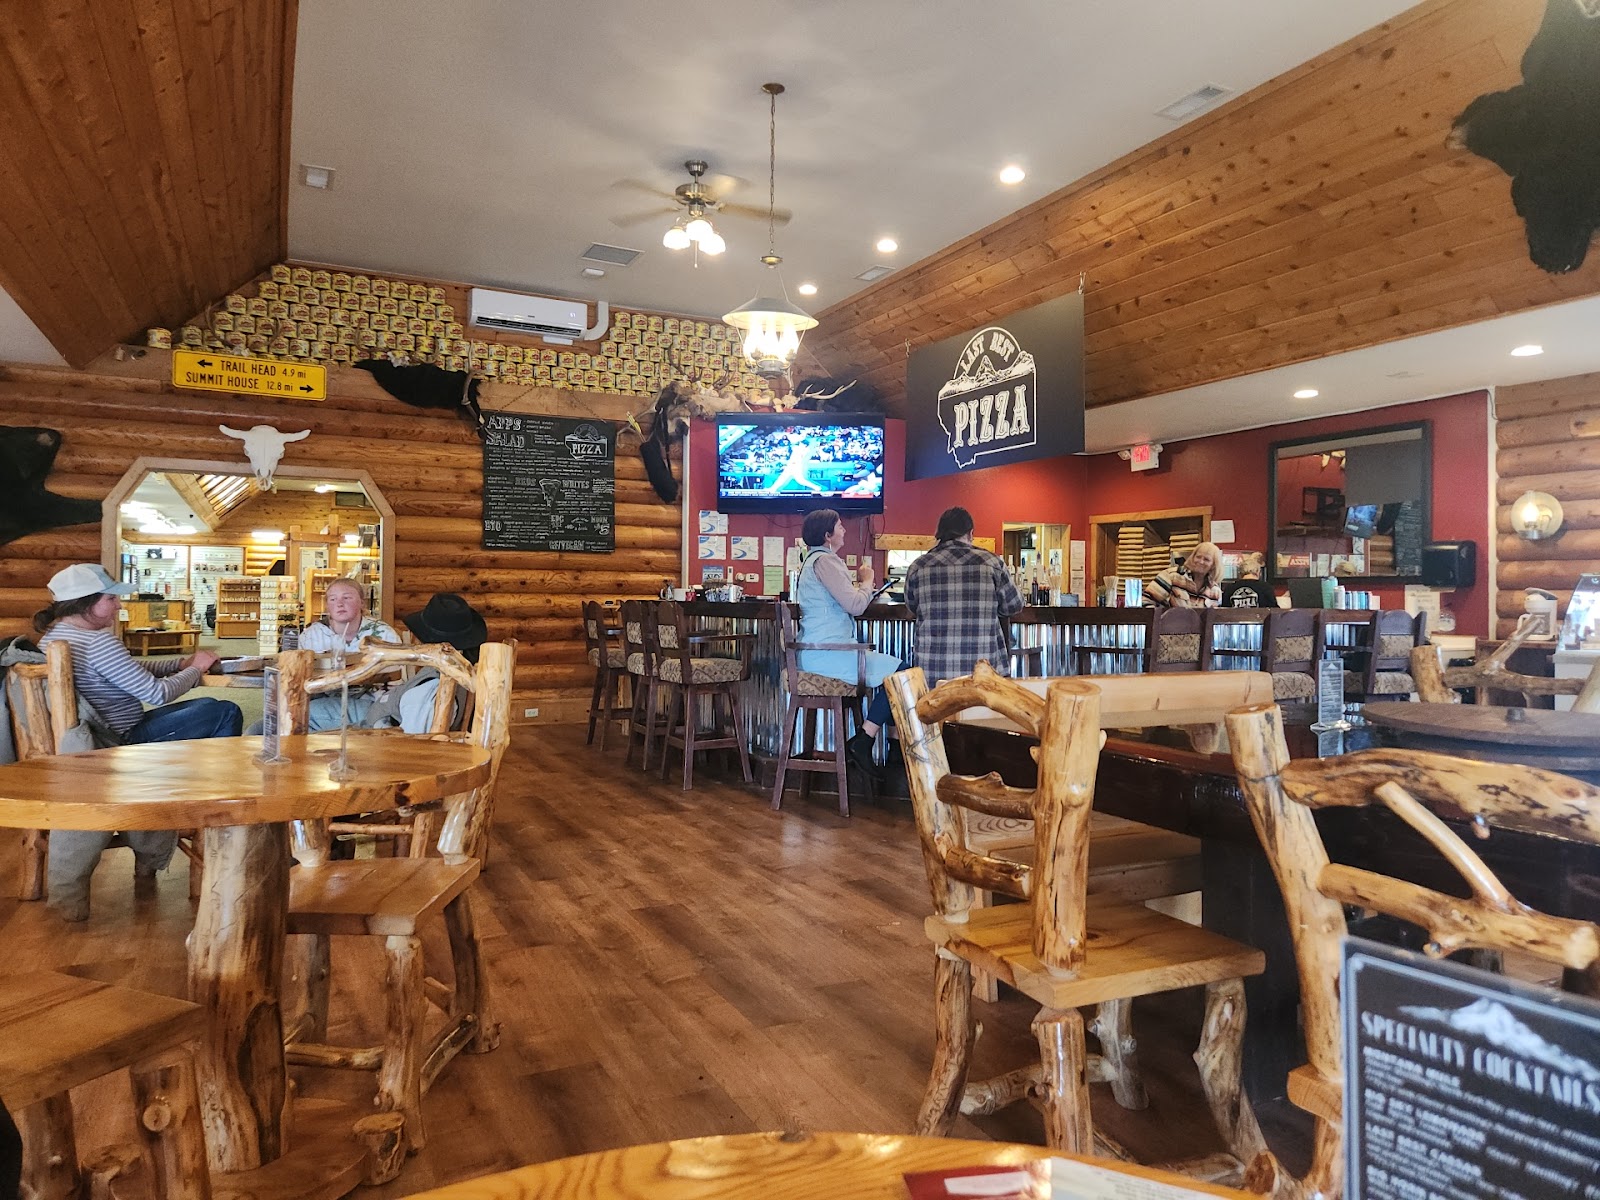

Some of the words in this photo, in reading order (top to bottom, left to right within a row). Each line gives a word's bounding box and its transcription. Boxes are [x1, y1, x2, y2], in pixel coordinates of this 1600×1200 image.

[960, 334, 985, 374] LAST
[989, 331, 1016, 363] BEST
[220, 360, 248, 374] TRAIL
[251, 364, 277, 376] HEAD
[282, 367, 295, 378] 4.9
[297, 369, 307, 379] mi
[186, 371, 224, 386] SUMMIT
[227, 375, 259, 390] HOUSE
[266, 380, 282, 391] 12.8
[284, 382, 293, 392] mi
[486, 414, 522, 431] APPS
[953, 384, 1031, 449] PIZZA
[485, 431, 525, 449] SALAD
[571, 442, 603, 455] PIZZA
[561, 479, 590, 490] WHITES
